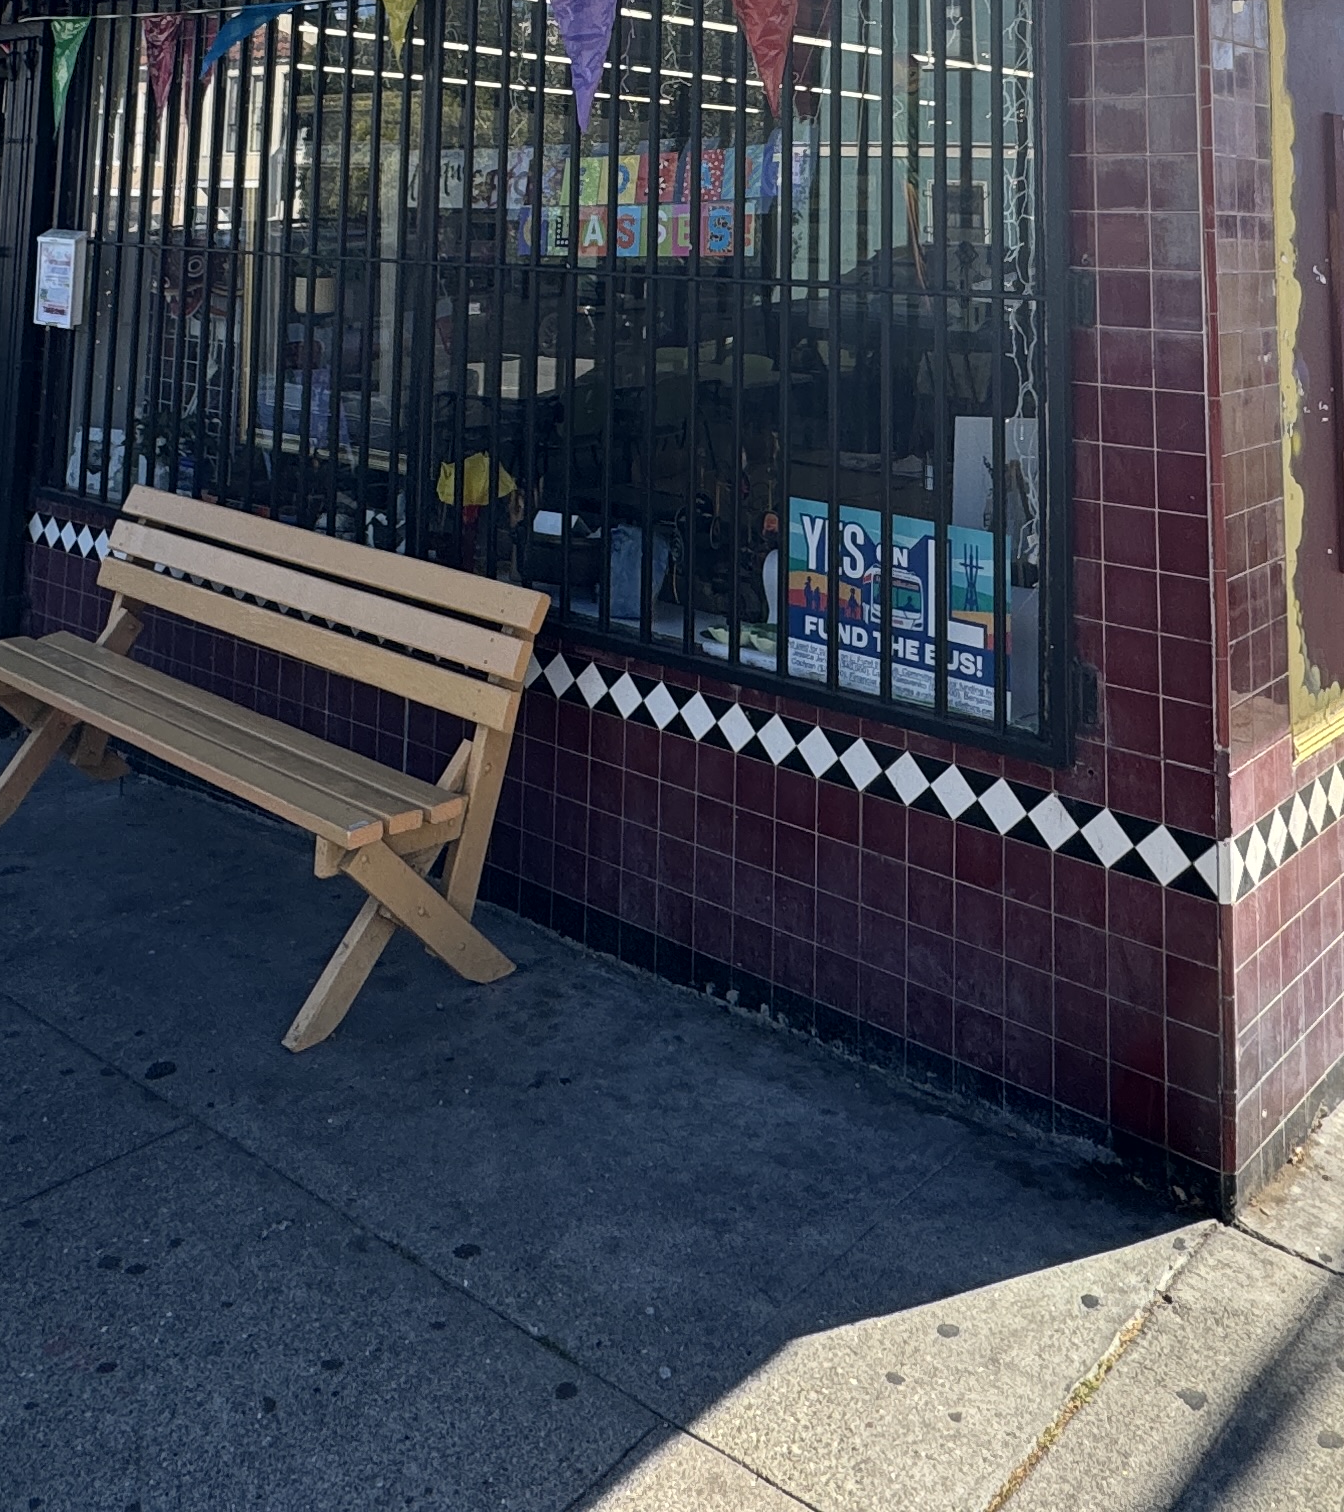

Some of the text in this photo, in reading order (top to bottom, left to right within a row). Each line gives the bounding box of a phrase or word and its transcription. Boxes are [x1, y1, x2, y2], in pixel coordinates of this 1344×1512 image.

[805, 615, 983, 679] FUND THE BUS!
